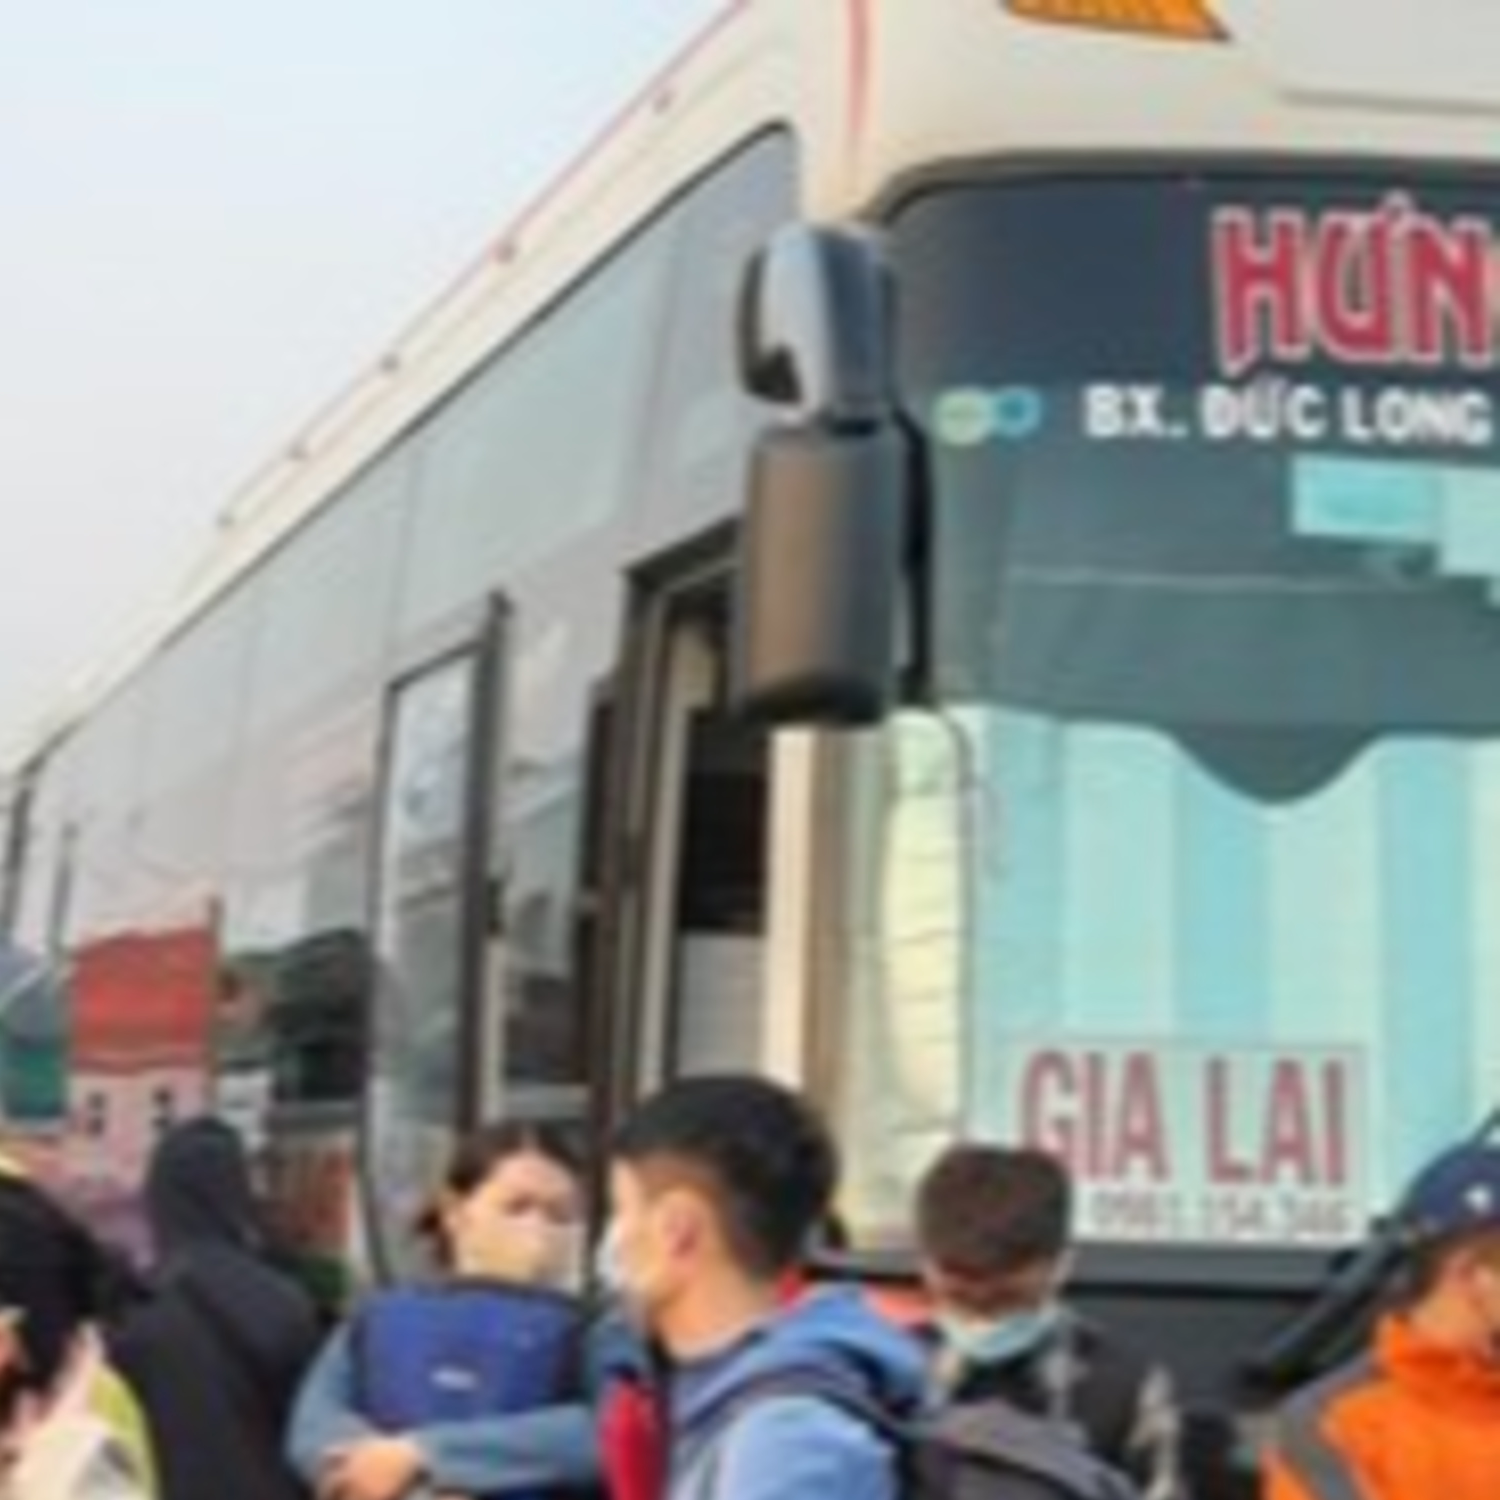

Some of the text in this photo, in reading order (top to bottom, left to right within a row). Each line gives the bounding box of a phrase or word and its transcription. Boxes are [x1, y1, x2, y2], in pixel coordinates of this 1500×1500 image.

[1213, 190, 1498, 374] HƯN
[1084, 376, 1493, 445] BX. ĐỨC LONG
[1021, 1049, 1347, 1188] GIA LAI
